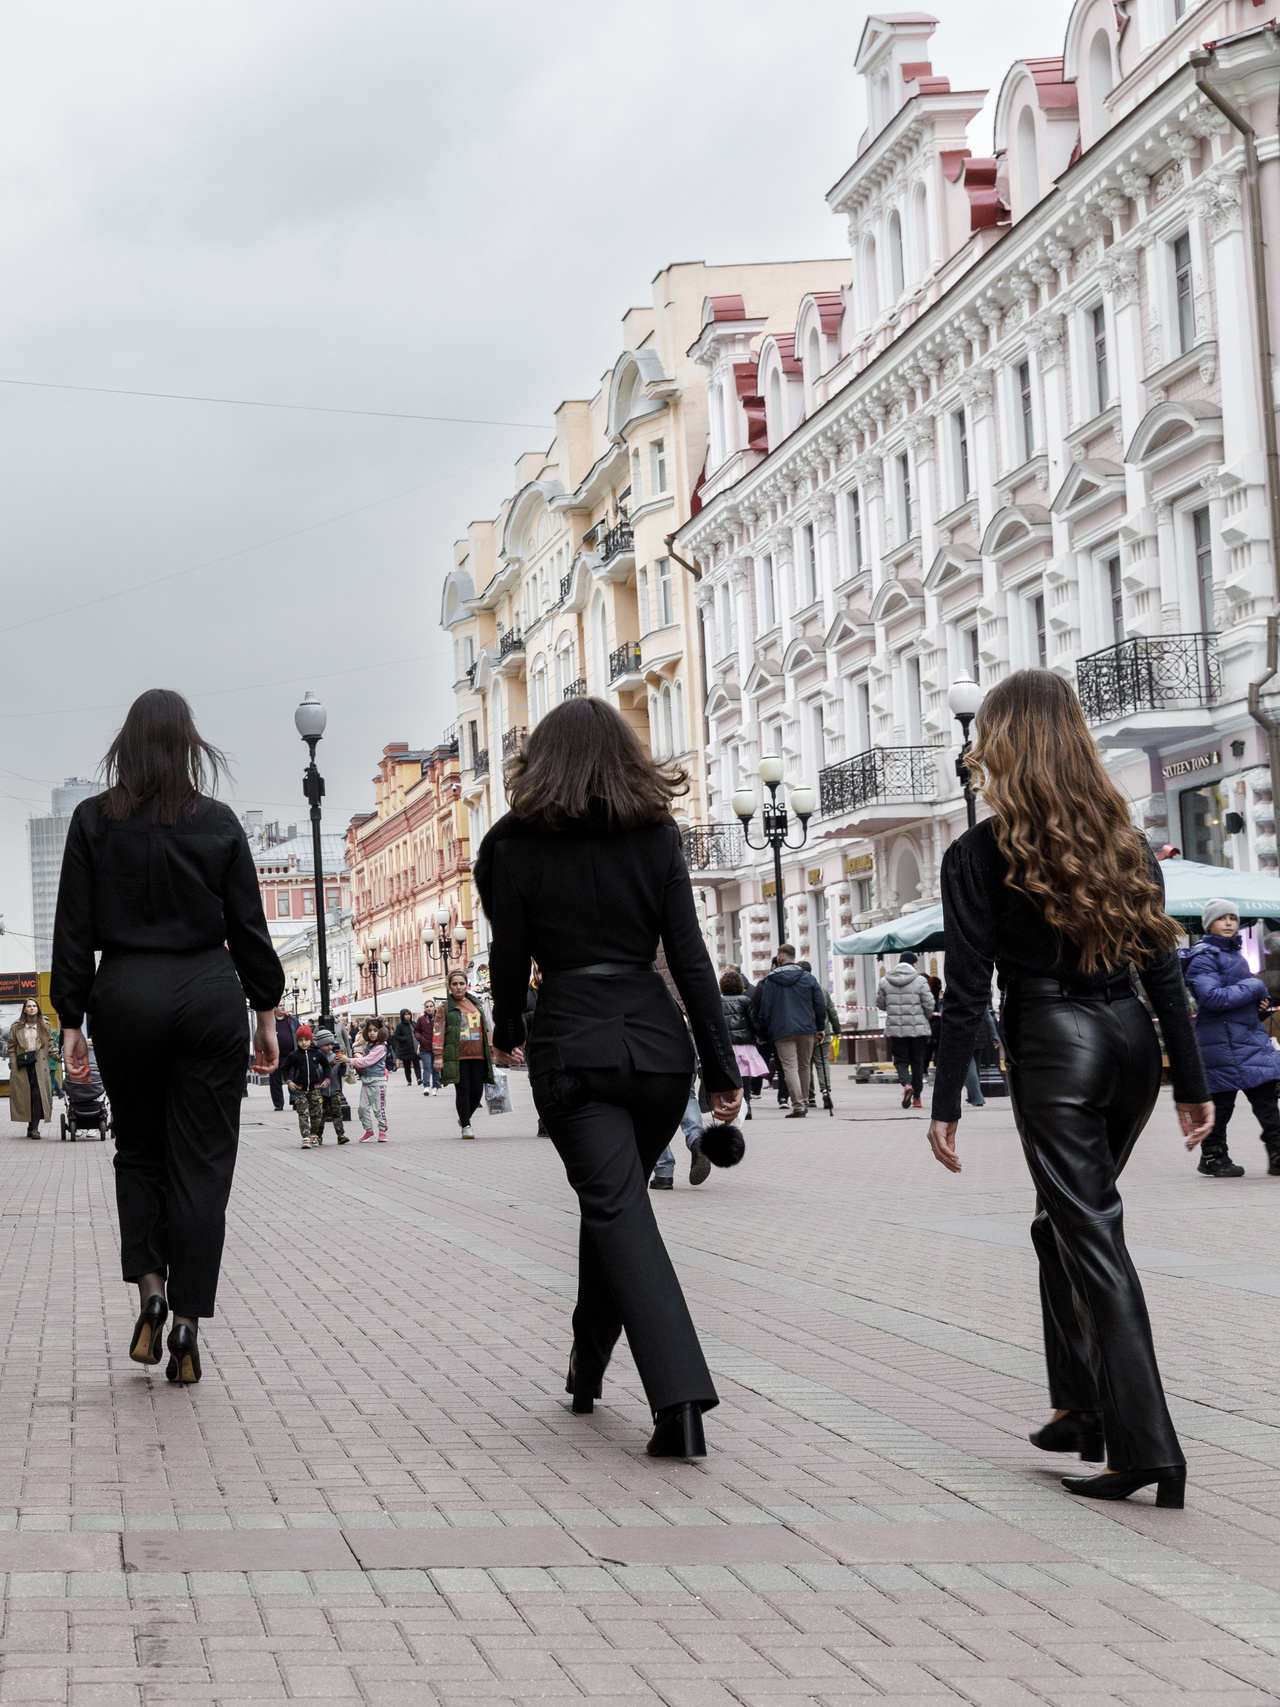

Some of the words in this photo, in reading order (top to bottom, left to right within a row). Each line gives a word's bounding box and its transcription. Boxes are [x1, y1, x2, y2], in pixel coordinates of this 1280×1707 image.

[1162, 759, 1192, 779] SIXTEEN
[1190, 754, 1210, 771] TONS
[1242, 901, 1280, 910] TONS
[21, 980, 36, 988] WC
